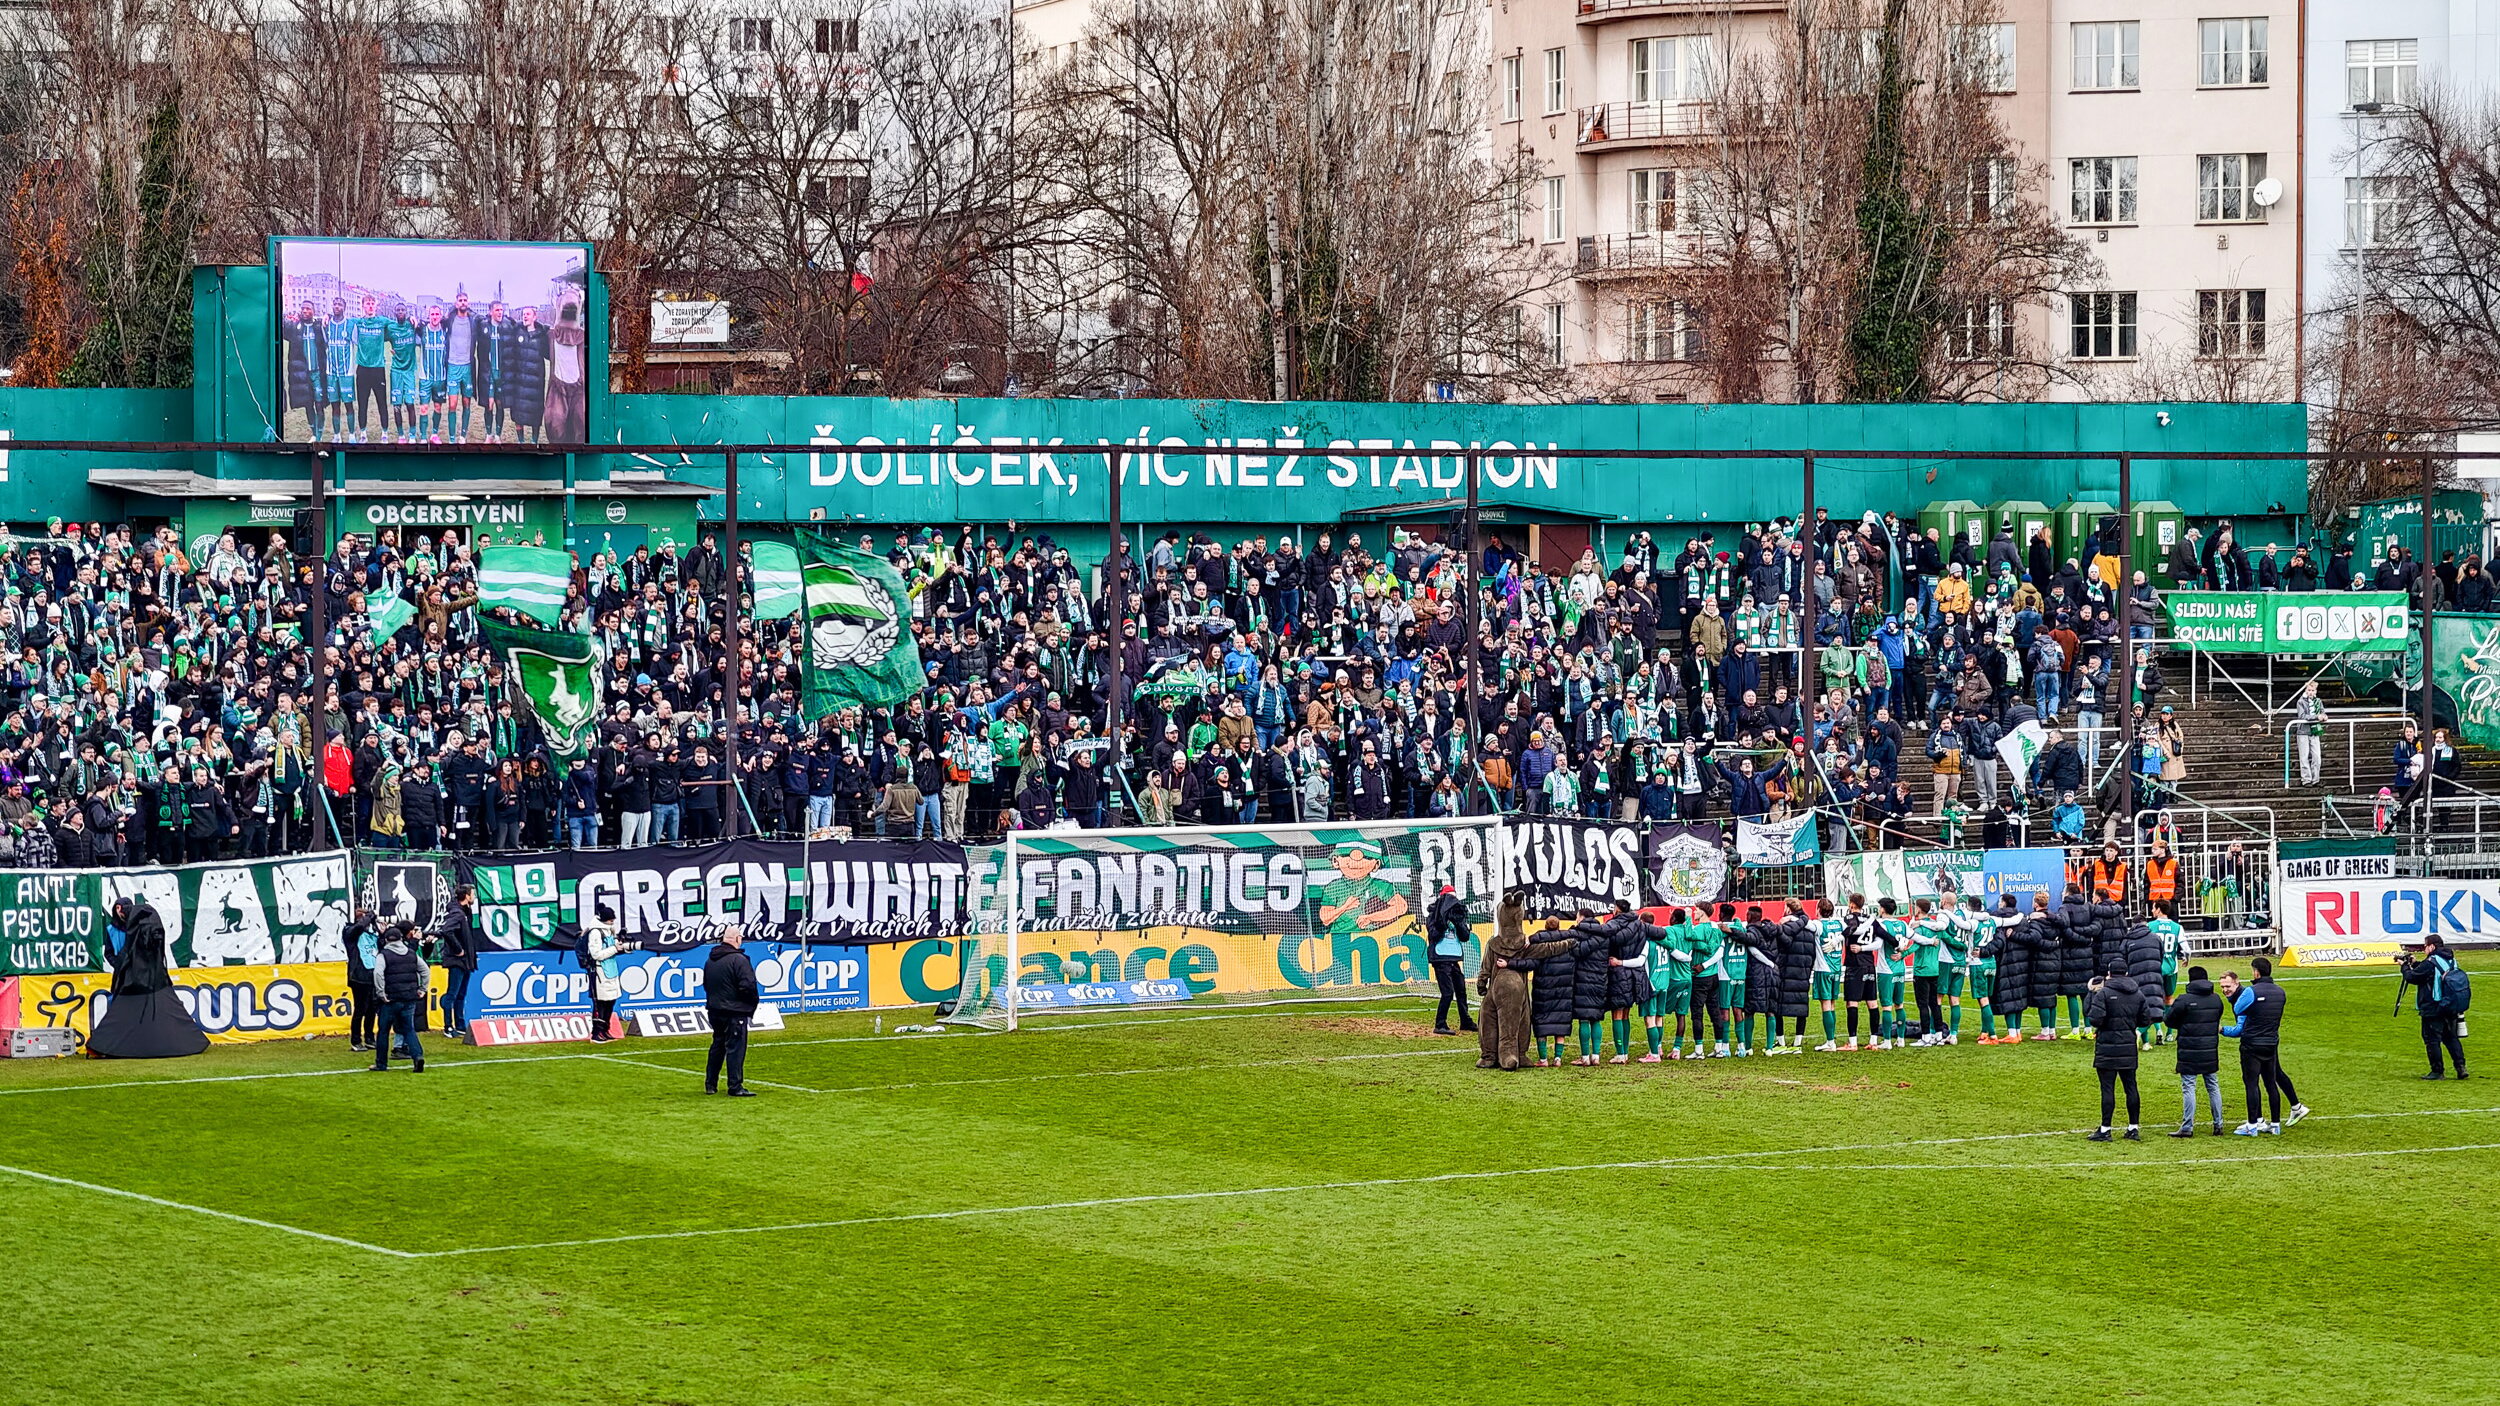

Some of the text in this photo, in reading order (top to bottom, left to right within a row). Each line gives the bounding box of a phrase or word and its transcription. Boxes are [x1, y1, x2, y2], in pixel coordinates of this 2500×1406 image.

[809, 424, 1078, 497] ĎOLÍČEK,
[1098, 426, 1189, 487] VÍC
[1205, 425, 1304, 487] NEŽ
[366, 500, 525, 524] OBČERSTVENÍ
[2373, 542, 2382, 556] B
[2174, 600, 2257, 619] SLEDUJ NAŠE
[2173, 623, 2264, 642] SOCIÁLNÍ SÍTĚ
[1746, 852, 1793, 865] BOHEMIANS
[1907, 852, 1983, 868] BOHEMIANS
[2287, 857, 2390, 878] GANG OF GREENS
[2004, 871, 2033, 882] PRAŽSKÁ
[2005, 881, 2050, 893] PLYNÁRENSKÁ
[17, 875, 77, 904] ANTI
[579, 852, 1302, 934] GREEN WHITE FANATICS
[1553, 891, 1575, 912] SMĚR
[3, 906, 92, 938] PSEUDO
[795, 918, 820, 938] ta
[829, 919, 848, 937] v
[1032, 904, 1119, 932] navždy
[2306, 891, 2360, 936] RI
[10, 940, 90, 969] ULTRAS
[2310, 948, 2366, 962] IMPULS
[660, 959, 704, 999] ČP
[795, 951, 861, 991] ČPP
[900, 938, 1219, 1003] Chance
[1025, 988, 1054, 1003] ČPP
[1088, 985, 1116, 1000] ČPP
[1149, 981, 1178, 996] ČPP
[90, 979, 304, 1034] IULS
[833, 997, 860, 1006] GROUP
